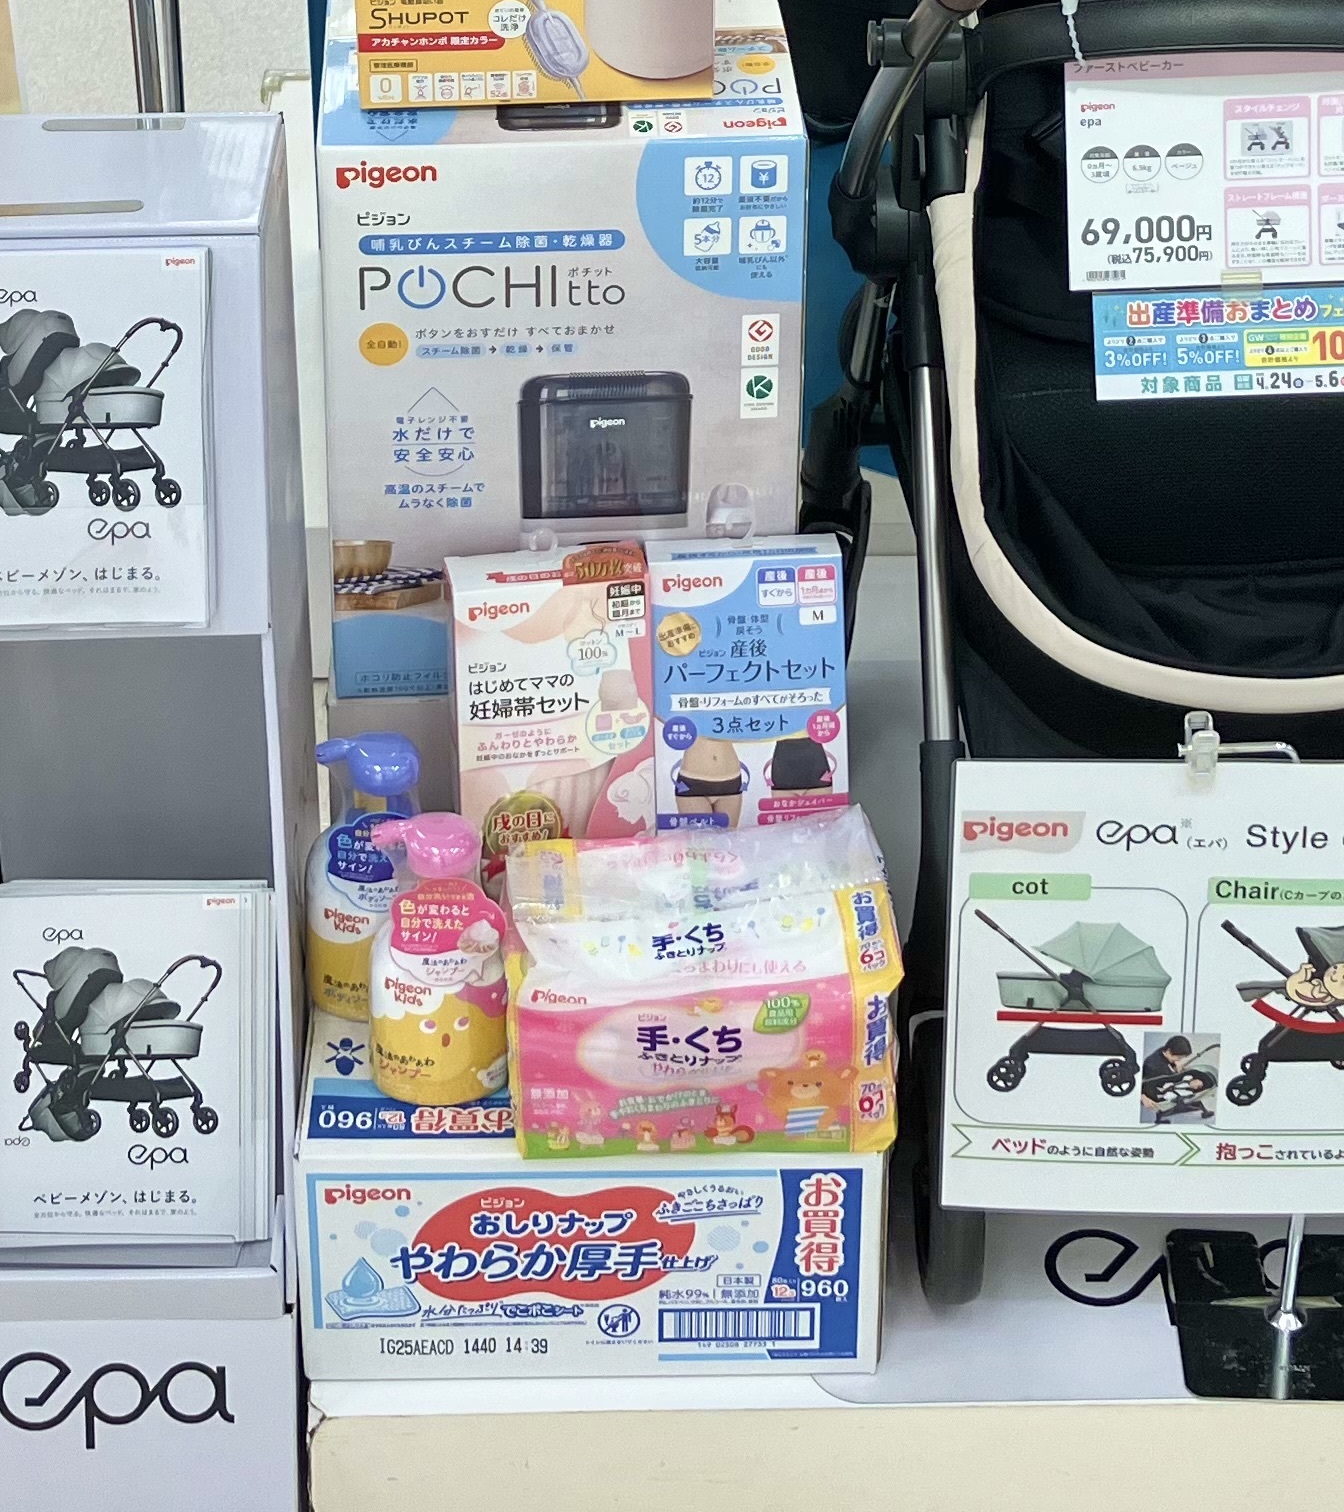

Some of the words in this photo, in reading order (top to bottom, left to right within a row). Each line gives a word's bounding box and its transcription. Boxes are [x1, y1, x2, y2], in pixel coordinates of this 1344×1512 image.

[369, 8, 469, 29] SHUPOT
[493, 15, 526, 23] コレだけ
[450, 36, 498, 45] 限定カラー
[1073, 60, 1184, 74] ファーストベビーカー
[1080, 103, 1115, 112] pigeon
[1234, 103, 1300, 115] スタイルチェンジ
[1080, 117, 1102, 128] epa
[1171, 162, 1198, 170] ベージュ
[336, 161, 437, 189] pigeon
[703, 173, 714, 183] 12
[356, 211, 410, 227] ピジョン
[1081, 215, 1212, 246] 69,000円
[371, 233, 613, 252] 哺乳びんスチーム除菌・乾燥器
[166, 257, 195, 267] pigeon
[1108, 246, 1213, 264] (税込75,900円)
[567, 266, 613, 278] ポチット
[359, 264, 555, 311] POCHI
[415, 326, 518, 339] ボタンをおすだけ
[527, 323, 615, 336] すべておまかせ
[422, 345, 481, 357] スチーム除菌
[505, 344, 528, 355] 乾燥
[551, 343, 573, 354] 保管
[1104, 350, 1167, 368] 3%OFF!
[1177, 349, 1241, 366] 5%OFF!
[1141, 376, 1222, 393] 対象商品
[590, 415, 626, 428] pigeon
[393, 426, 475, 442] 水だけで
[393, 447, 475, 464] 安全安心
[384, 482, 485, 495] 高温のスチームで
[399, 497, 473, 508] ムラなく除菌
[87, 518, 152, 545] epa
[662, 575, 723, 593] pigeon
[761, 586, 793, 598] すぐから
[468, 602, 530, 622] pigeon
[812, 610, 825, 621] M
[731, 640, 767, 658] 産後
[468, 661, 506, 674] ピジョン
[664, 657, 835, 685] パーフェクトセット
[468, 673, 575, 696] はじめてママの
[469, 693, 590, 721] 妊婦帯セット
[712, 715, 789, 734] 3点セット
[477, 733, 578, 750] ふんわりとやわらか
[964, 816, 1068, 842] pigeon
[1246, 824, 1328, 854] Style
[1012, 878, 1049, 895] cot
[1215, 880, 1280, 900] Chair
[398, 899, 470, 917] 色が変わると
[324, 908, 370, 926] pigeon
[401, 915, 464, 929] 自分で洗えた
[43, 927, 83, 944] epa
[334, 922, 361, 936] kids
[384, 977, 432, 996] pigeon
[394, 992, 423, 1007] kids
[531, 989, 587, 1005] pigeon
[637, 1025, 742, 1052] 手・くち
[862, 995, 889, 1065] お買得
[379, 1061, 432, 1079] シャンプー
[128, 1144, 189, 1170] epa
[34, 1190, 197, 1205] ベビーメゾン、はじまる。
[324, 1188, 411, 1205] pigeon
[480, 1196, 525, 1208] ピジョン
[656, 1195, 763, 1218] ふきごこちさっぱり
[471, 1211, 634, 1237] おしりナップ
[798, 1174, 849, 1275] お買得
[723, 1276, 755, 1286] 日本製
[801, 1279, 849, 1298] 960
[719, 1288, 760, 1300] 無添加
[463, 1337, 497, 1355] 1440
